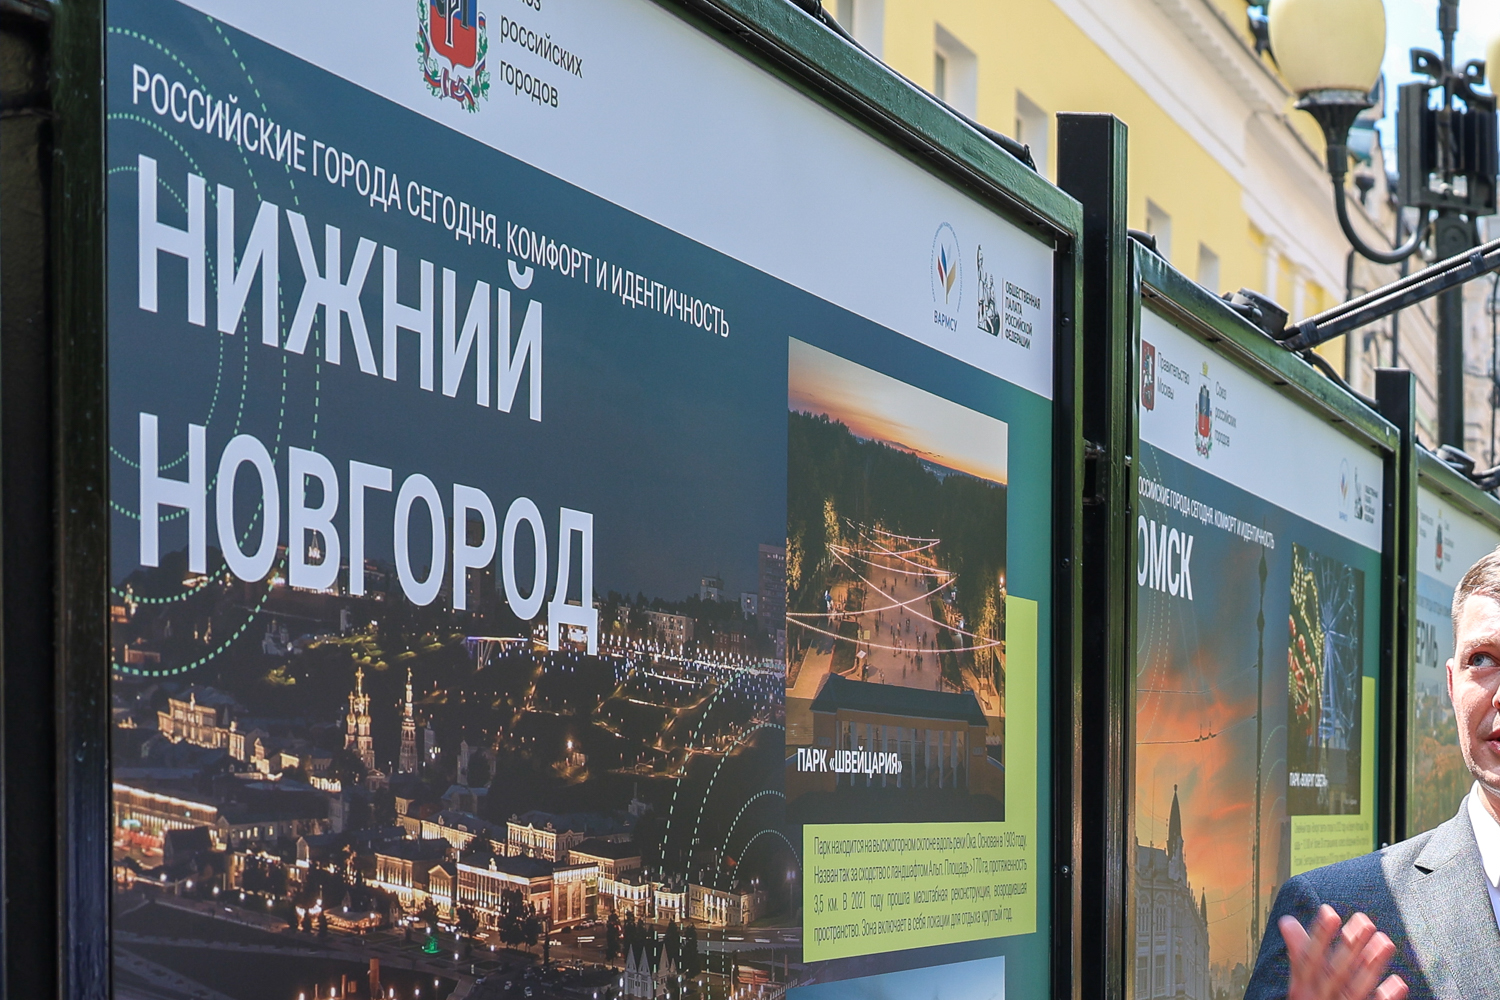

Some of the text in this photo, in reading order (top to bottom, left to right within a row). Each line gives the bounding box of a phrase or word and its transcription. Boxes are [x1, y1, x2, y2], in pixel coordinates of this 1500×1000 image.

[501, 14, 584, 79] российских
[500, 60, 559, 109] городов
[132, 63, 731, 338] РОССИЙСКИЕ ГОРОДА СЕГОДНЯ. КОМФОРТ И ИДЕНТИЧНОСТЬ
[138, 153, 544, 423] НИЖНИЙ
[1137, 475, 1171, 507] ОССИЙСКИЕ
[139, 410, 599, 657] НОВГОРОД
[1137, 514, 1194, 601] ОМСК
[1416, 618, 1438, 669] ЕРМЬ
[796, 745, 903, 779] ПАРК «ШВЕЙЦАРИЯ»
